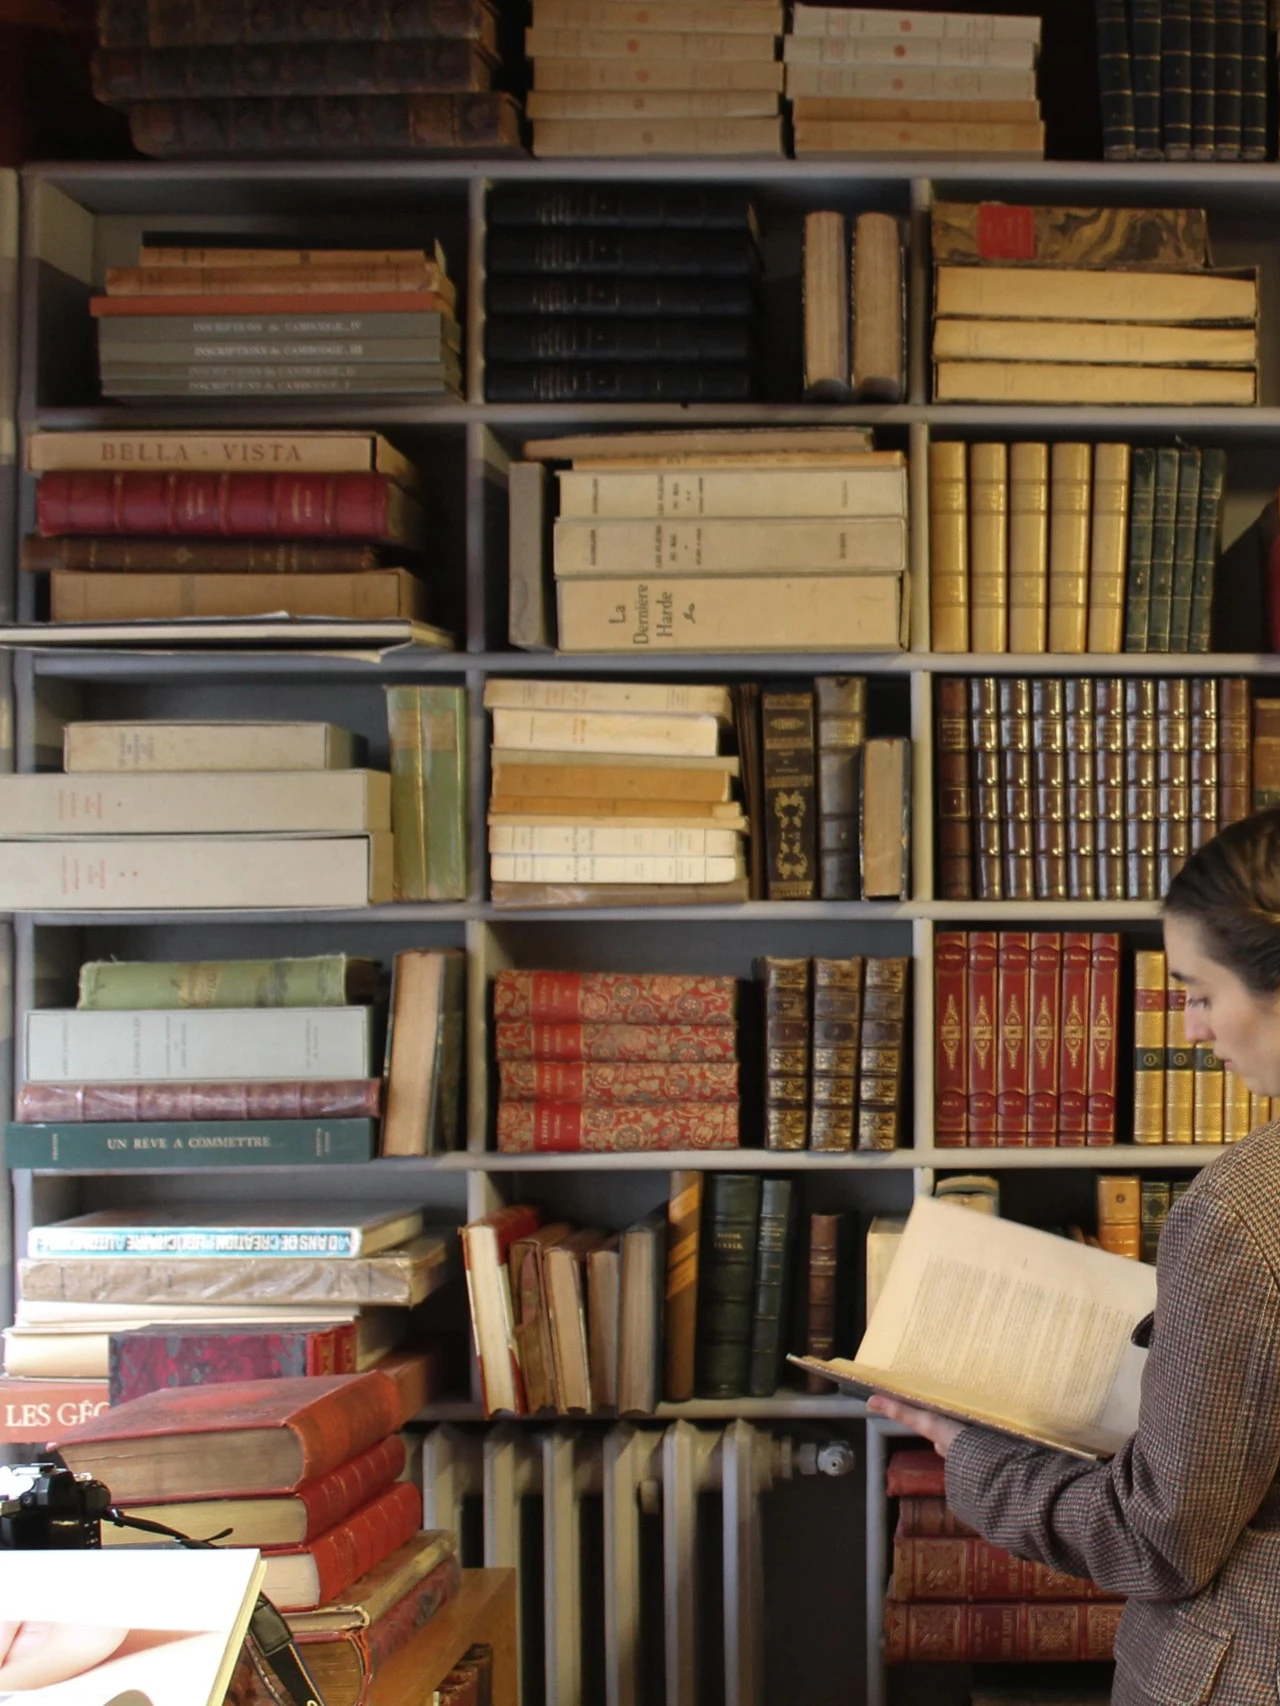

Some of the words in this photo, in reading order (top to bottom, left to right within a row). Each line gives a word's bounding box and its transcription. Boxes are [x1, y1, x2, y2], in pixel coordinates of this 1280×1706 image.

[101, 442, 190, 462] BELLA
[221, 442, 303, 462] VISTA
[609, 604, 626, 624] La
[656, 591, 673, 637] Harde
[107, 1139, 127, 1150] UN
[188, 1136, 271, 1149] COMMETTRE
[281, 1235, 299, 1250] DE
[300, 1235, 327, 1250] ANS
[5, 1402, 52, 1427] LES
